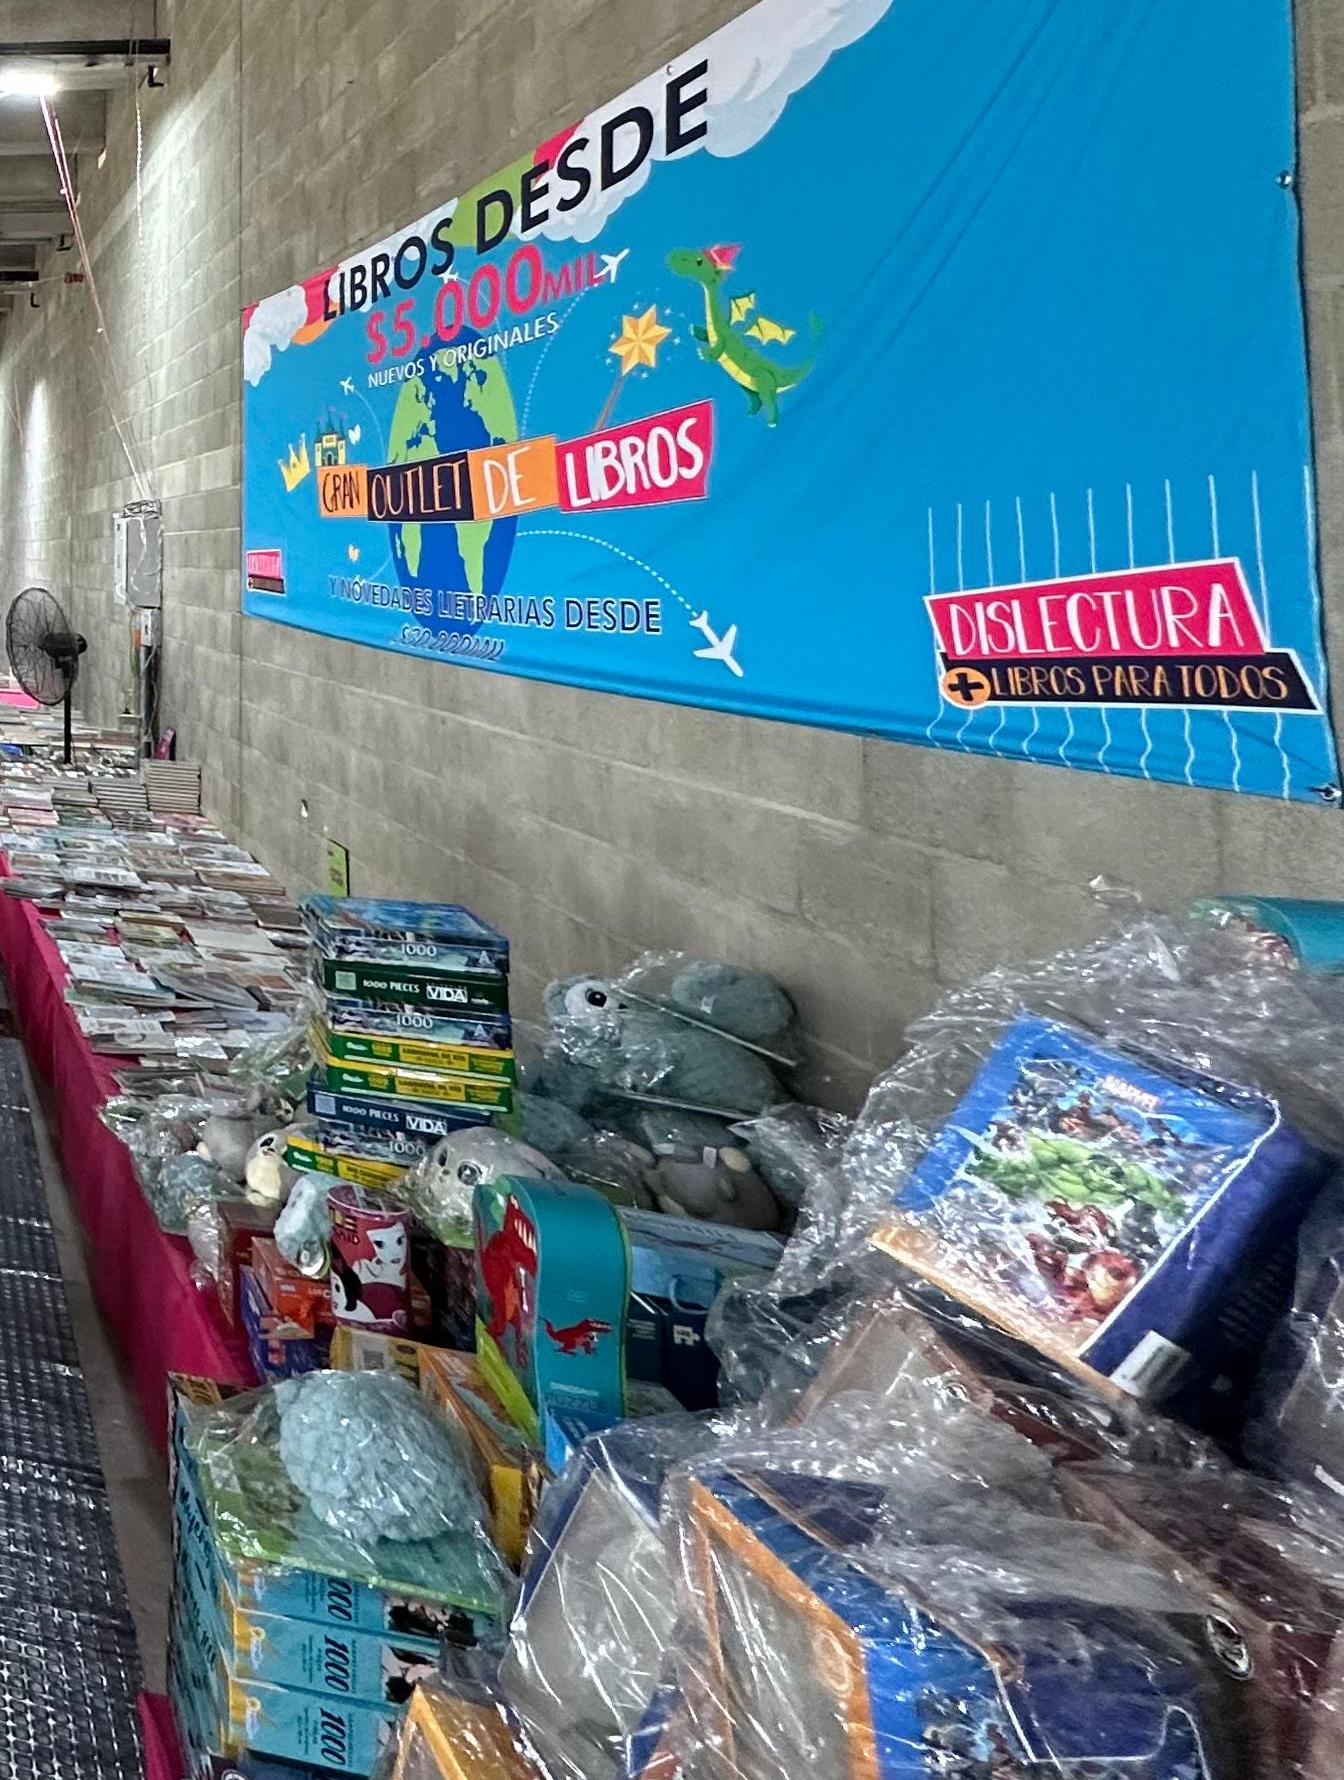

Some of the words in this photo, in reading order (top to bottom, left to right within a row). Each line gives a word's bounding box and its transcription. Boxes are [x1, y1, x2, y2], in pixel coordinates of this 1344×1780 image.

[323, 217, 454, 321] LIBROS
[476, 60, 709, 256] DESDE
[367, 358, 425, 390] NUEVOS
[428, 352, 440, 373] Y
[443, 312, 561, 368] ORIGINALES
[321, 468, 361, 514] GRAN
[371, 457, 469, 519] OUTLET
[484, 446, 539, 516] DE
[564, 417, 707, 508] LIBROS
[340, 577, 433, 616] NOVEDADES
[565, 597, 662, 635] DESDE
[950, 582, 1245, 656] DISLECTURA
[991, 667, 1085, 698] LIBROS
[1096, 667, 1169, 697] PARA
[1179, 667, 1289, 700] TODOS
[400, 943, 438, 957] 1000
[363, 979, 388, 990] 1000
[390, 981, 420, 994] PIECES
[395, 1013, 433, 1029] 1000
[342, 1105, 366, 1116] 1000
[369, 1108, 399, 1122] PIECES
[389, 1140, 426, 1156] 1000
[324, 1634, 351, 1693] 1000
[320, 1707, 347, 1766] 1000
